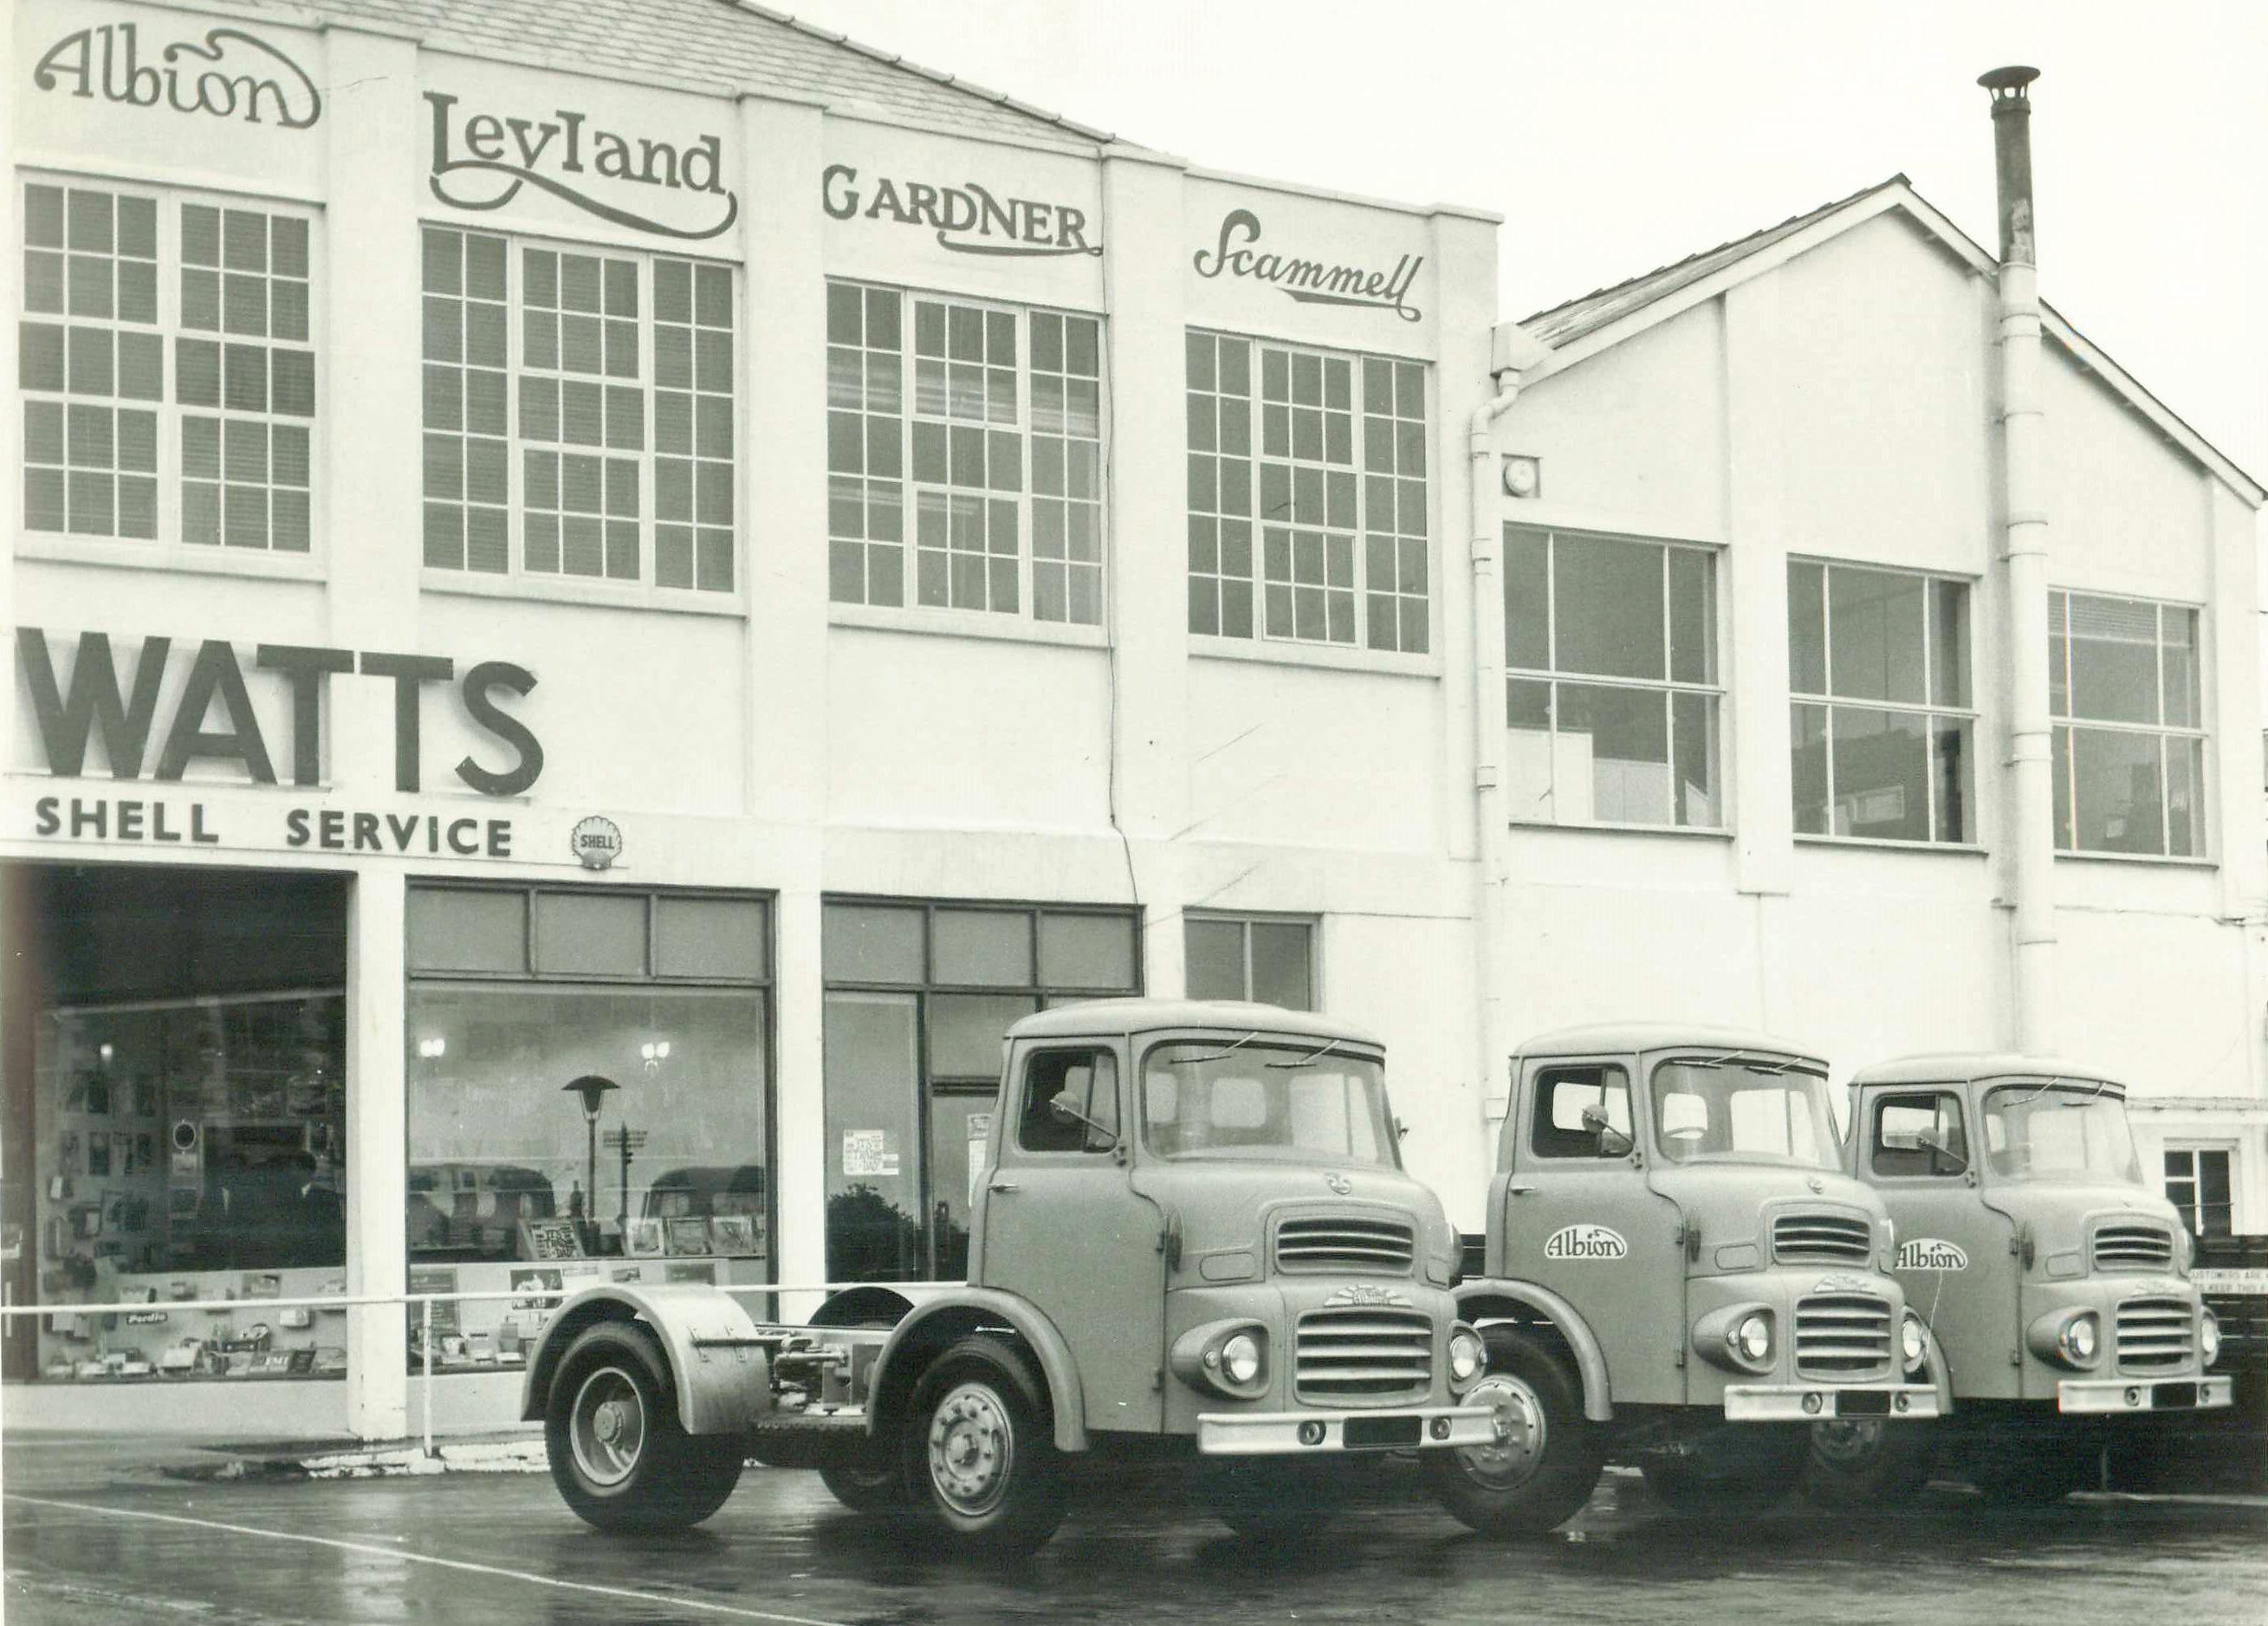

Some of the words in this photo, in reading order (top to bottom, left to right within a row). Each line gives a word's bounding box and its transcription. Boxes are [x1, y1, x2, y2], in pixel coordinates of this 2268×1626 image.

[33, 23, 322, 130] Albion
[422, 91, 739, 241] Leyland
[821, 164, 1104, 258] GARDNER
[1193, 208, 1423, 322] Scammell
[15, 626, 544, 797] WATTS
[36, 796, 220, 844] SHELL
[286, 809, 512, 857] SERVICE
[580, 834, 615, 850] SHELL
[1546, 1228, 1626, 1257] Albion
[1895, 1242, 1967, 1268] Albion
